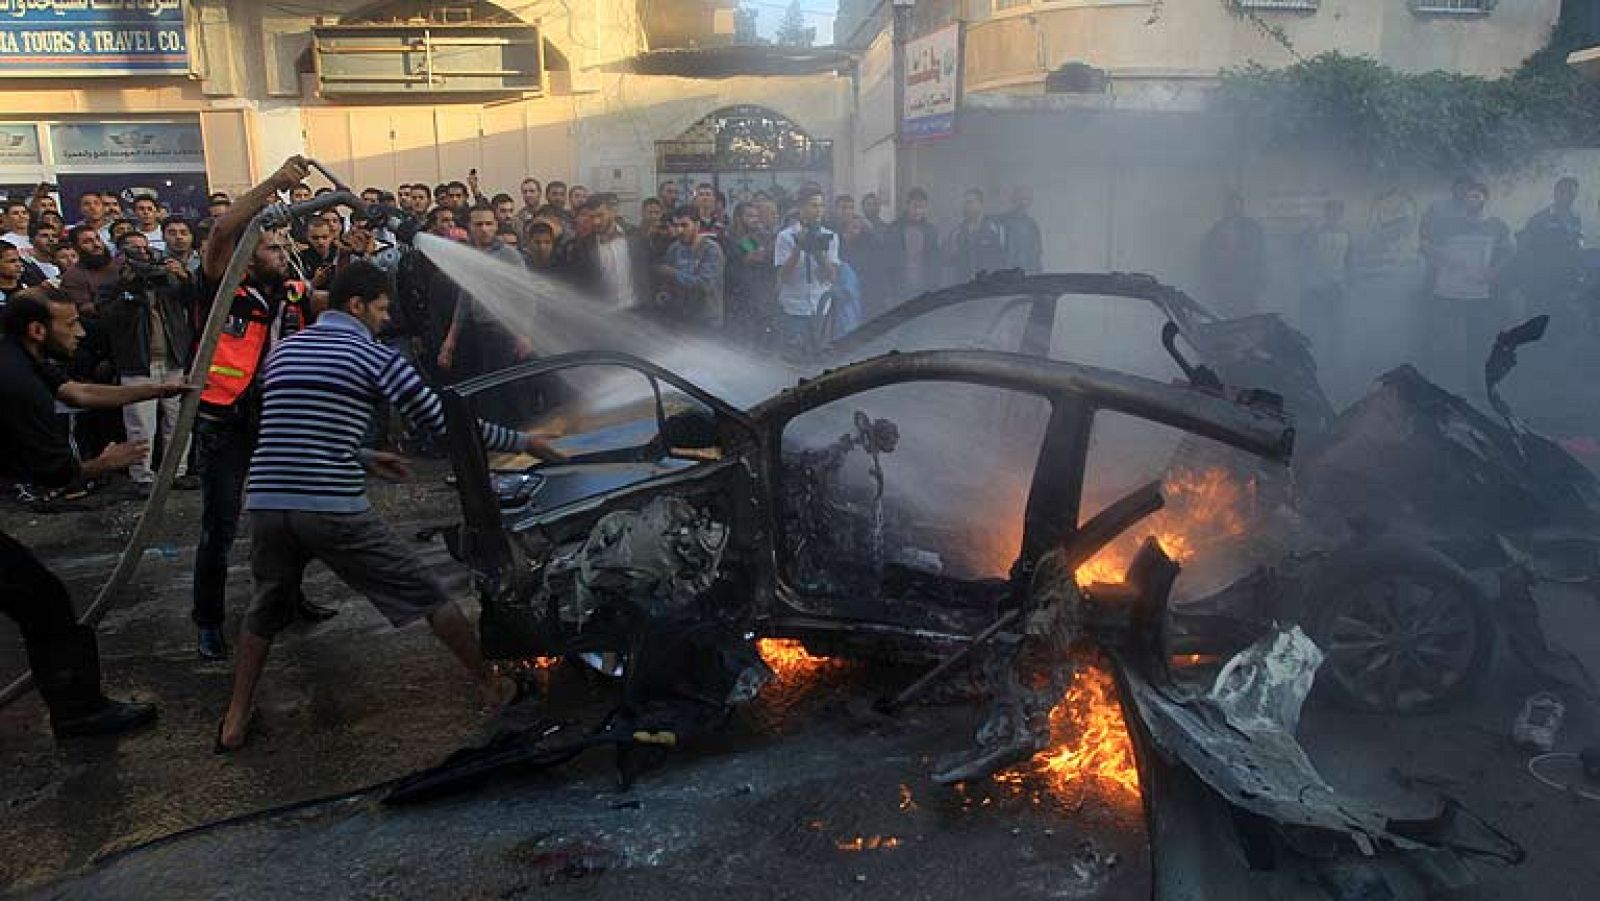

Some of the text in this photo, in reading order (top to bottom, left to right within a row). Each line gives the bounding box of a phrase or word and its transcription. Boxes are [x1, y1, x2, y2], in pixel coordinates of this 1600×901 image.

[21, 30, 75, 52] TOURS
[79, 30, 91, 52] &
[92, 30, 154, 52] TRAVEL
[158, 30, 184, 51] CO.
